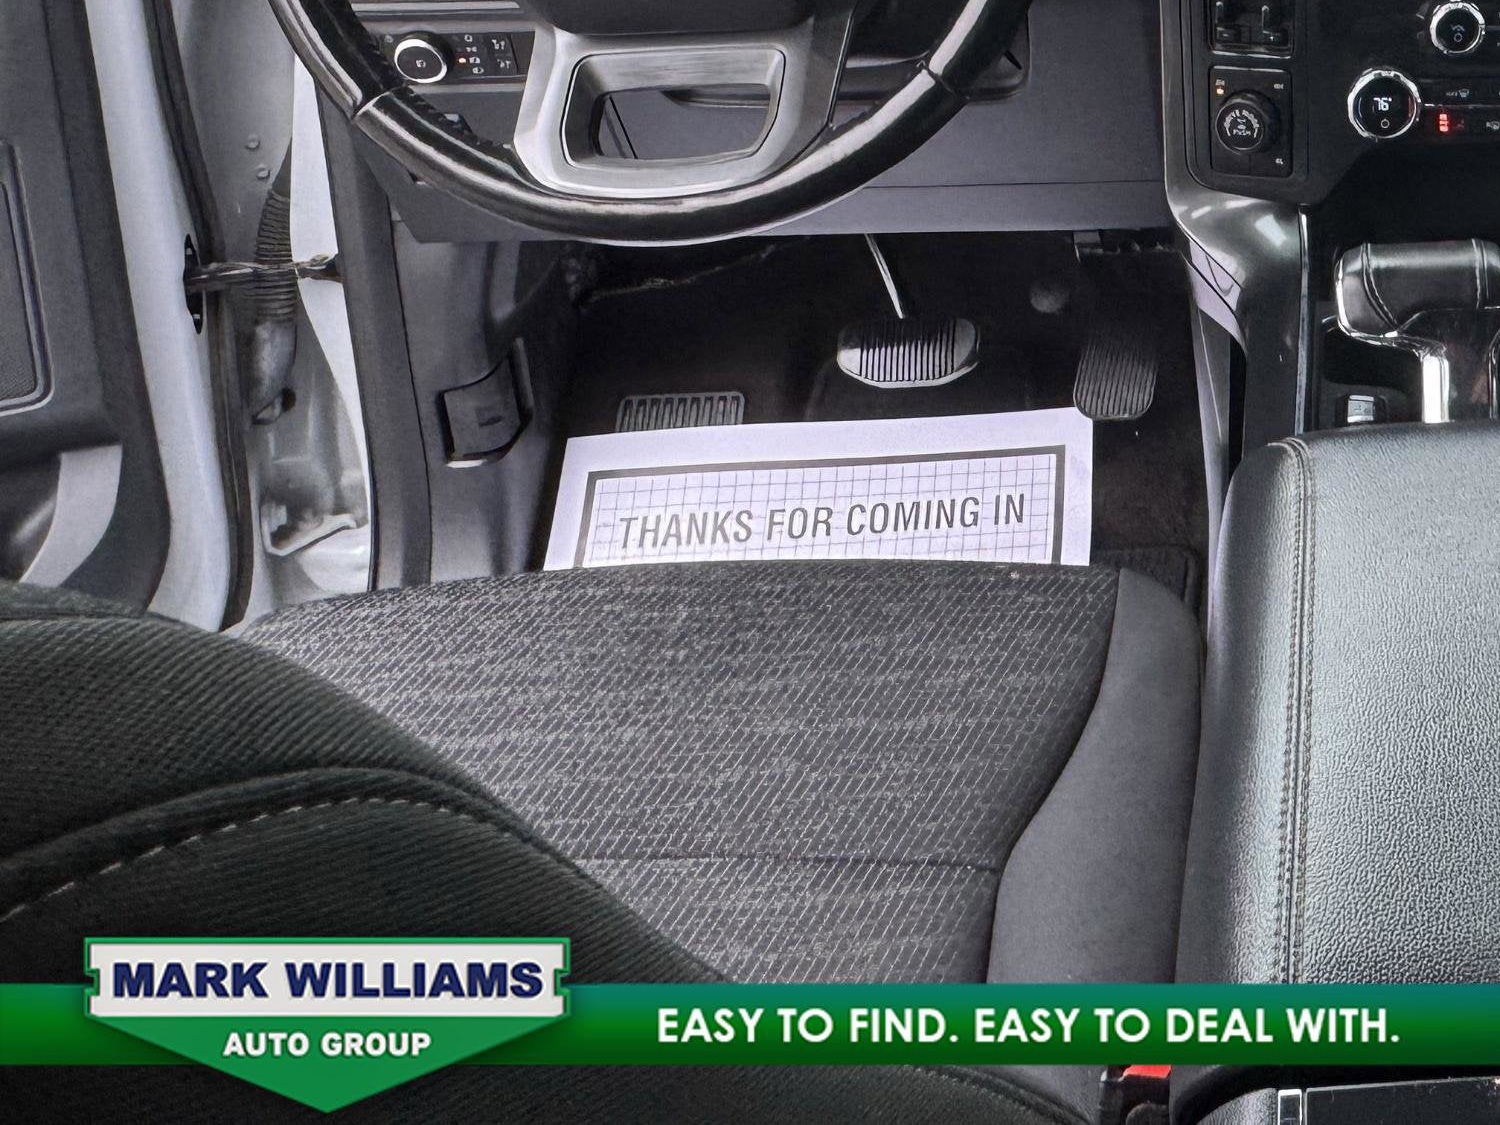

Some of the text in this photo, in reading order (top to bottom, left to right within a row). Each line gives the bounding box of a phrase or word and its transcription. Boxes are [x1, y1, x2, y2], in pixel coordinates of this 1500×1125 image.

[619, 493, 1024, 549] THANKS FOR COMING IN
